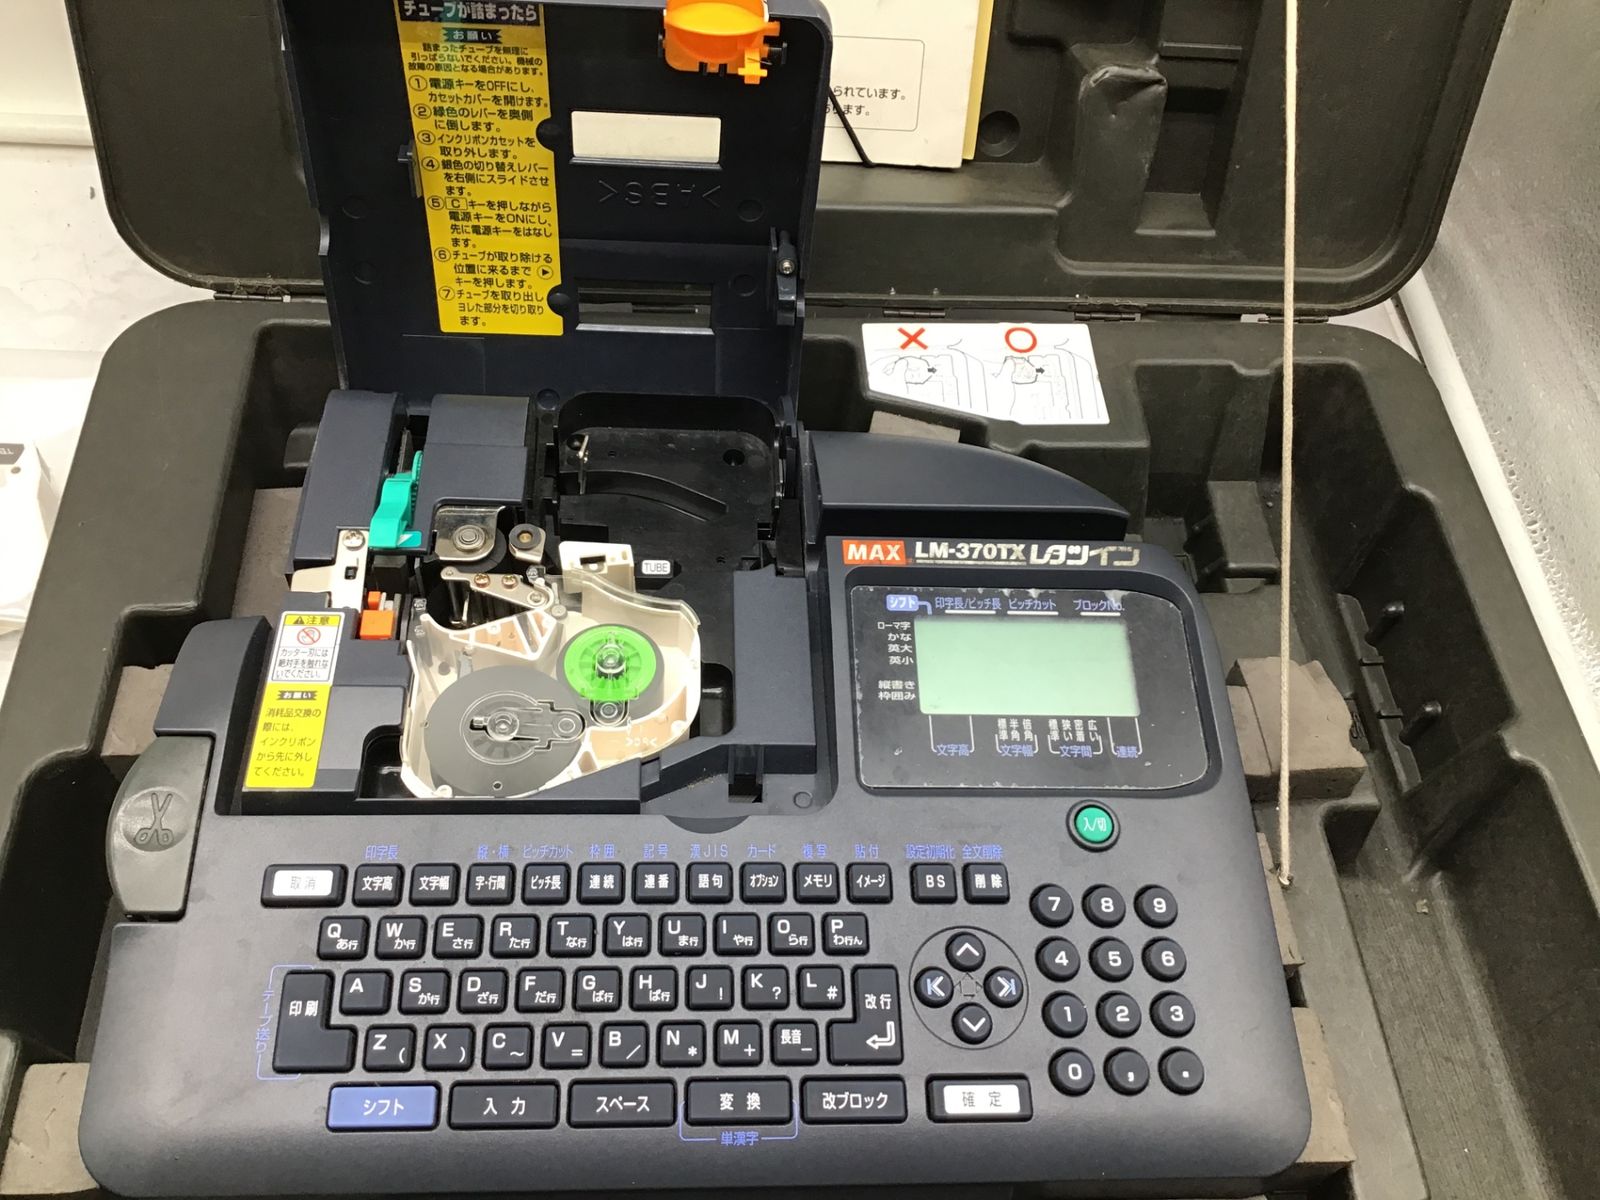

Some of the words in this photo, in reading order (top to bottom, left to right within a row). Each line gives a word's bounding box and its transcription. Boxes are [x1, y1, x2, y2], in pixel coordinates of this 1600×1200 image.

[403, 1, 538, 21] チューブが詰まったら
[453, 30, 492, 40] お願い
[434, 119, 501, 133] に倒します。
[440, 146, 518, 160] 取り外します。
[444, 172, 549, 186] を右側にスライドさせ
[446, 186, 472, 196] ます。
[450, 224, 553, 238] 先に電源キーをはなし
[451, 238, 477, 249] ます。
[455, 277, 533, 290] キーを押します。
[460, 316, 486, 327] ます。
[847, 543, 901, 561] MAX
[915, 541, 1026, 560] LM-370TX
[644, 562, 668, 573] TUBE
[889, 597, 916, 609] シフト
[1008, 598, 1057, 610] ピッチカット
[877, 621, 911, 630] ローマ字
[888, 632, 912, 641] かな
[888, 643, 913, 653] 英大
[888, 655, 914, 665] 英小
[256, 751, 313, 762] から先に外し
[254, 766, 305, 777] てください。
[365, 845, 399, 860] 印字長
[523, 844, 573, 859] ピッチカット
[644, 844, 669, 858] 記号
[748, 844, 776, 858] カード
[362, 875, 393, 891] 文字高
[419, 875, 450, 891] 文字幅
[530, 875, 561, 890] ピッチ長
[589, 874, 615, 889] 連続
[644, 874, 670, 889] 連番
[698, 874, 723, 889] 語句
[803, 874, 832, 888] メモリ
[856, 874, 886, 888] イメージ
[926, 874, 945, 888] BS
[1048, 897, 1060, 912] 7
[1101, 897, 1114, 913] 8
[1153, 898, 1167, 913] 9
[327, 923, 341, 938] Q
[386, 923, 403, 937] W
[442, 922, 454, 937] E
[500, 922, 512, 936] R
[557, 921, 569, 935] T
[613, 921, 626, 935] Y
[668, 920, 681, 934] U
[777, 919, 791, 934] O
[831, 919, 844, 933] P
[336, 938, 359, 950] あ行
[394, 938, 416, 950] か行
[452, 938, 473, 950] さ行
[509, 937, 530, 949] た行
[566, 936, 587, 948] な行
[622, 935, 643, 947] は行
[678, 935, 699, 947] ま行
[733, 934, 753, 946] や行
[788, 934, 808, 946] ら行
[833, 934, 862, 946] わ行ん
[1055, 951, 1068, 966] 4
[1108, 951, 1122, 966] 5
[1161, 951, 1175, 966] 6
[350, 978, 364, 993] A
[409, 978, 422, 992] S
[467, 977, 481, 992] D
[524, 976, 537, 991] F
[582, 975, 596, 990] G
[639, 975, 652, 989] H
[695, 974, 707, 989] J
[751, 973, 763, 988] K
[807, 973, 817, 987] L
[418, 992, 440, 1005] が行
[477, 992, 499, 1004] ざ行
[534, 991, 556, 1004] だ行
[864, 994, 892, 1009] 改行
[288, 1000, 318, 1017] 印刷
[1063, 1007, 1072, 1022] 1
[1116, 1006, 1129, 1022] 2
[1170, 1006, 1184, 1021] 3
[373, 1035, 386, 1050] Z
[433, 1034, 447, 1049] X
[492, 1033, 506, 1048] C
[552, 1032, 565, 1047] V
[609, 1031, 622, 1046] B
[666, 1031, 680, 1045] N
[724, 1030, 739, 1044] M
[1068, 1064, 1082, 1080] 0
[363, 1098, 404, 1116] シフト
[483, 1097, 526, 1116] 入力
[596, 1095, 650, 1113] スペース
[719, 1093, 761, 1111] 変換
[822, 1092, 888, 1110] 改ブロック
[721, 1131, 759, 1146] 単漢字
